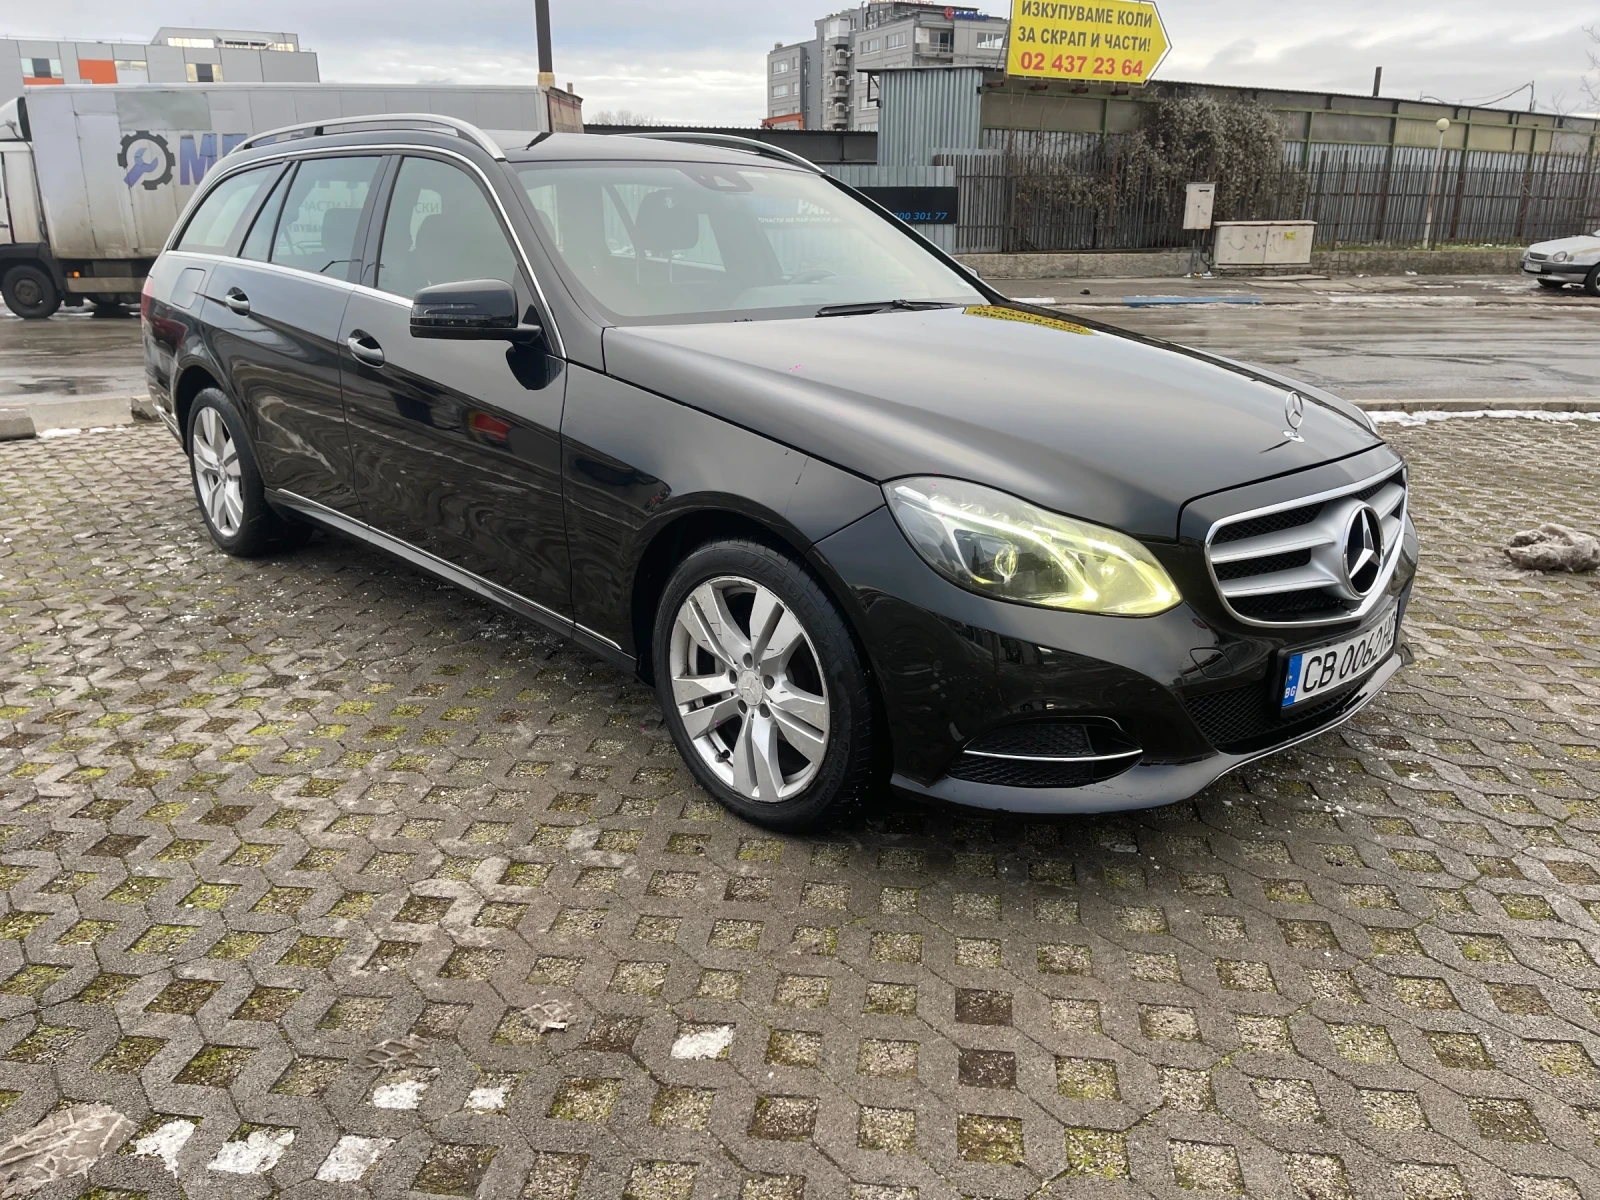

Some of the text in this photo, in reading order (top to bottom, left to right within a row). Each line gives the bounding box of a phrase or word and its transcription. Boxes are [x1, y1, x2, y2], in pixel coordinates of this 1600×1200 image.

[1021, 0, 1152, 28] ИЗКУПУВАМЕ КОЛИ
[1018, 26, 1151, 52] ЗА СКРАП И ЧАСТИ!
[1021, 52, 1143, 76] 02 437 23 64
[914, 212, 931, 220] 301
[935, 212, 948, 220] 77
[1303, 651, 1337, 693] CB
[1339, 626, 1383, 679] 0062
[1284, 686, 1296, 698] BG
